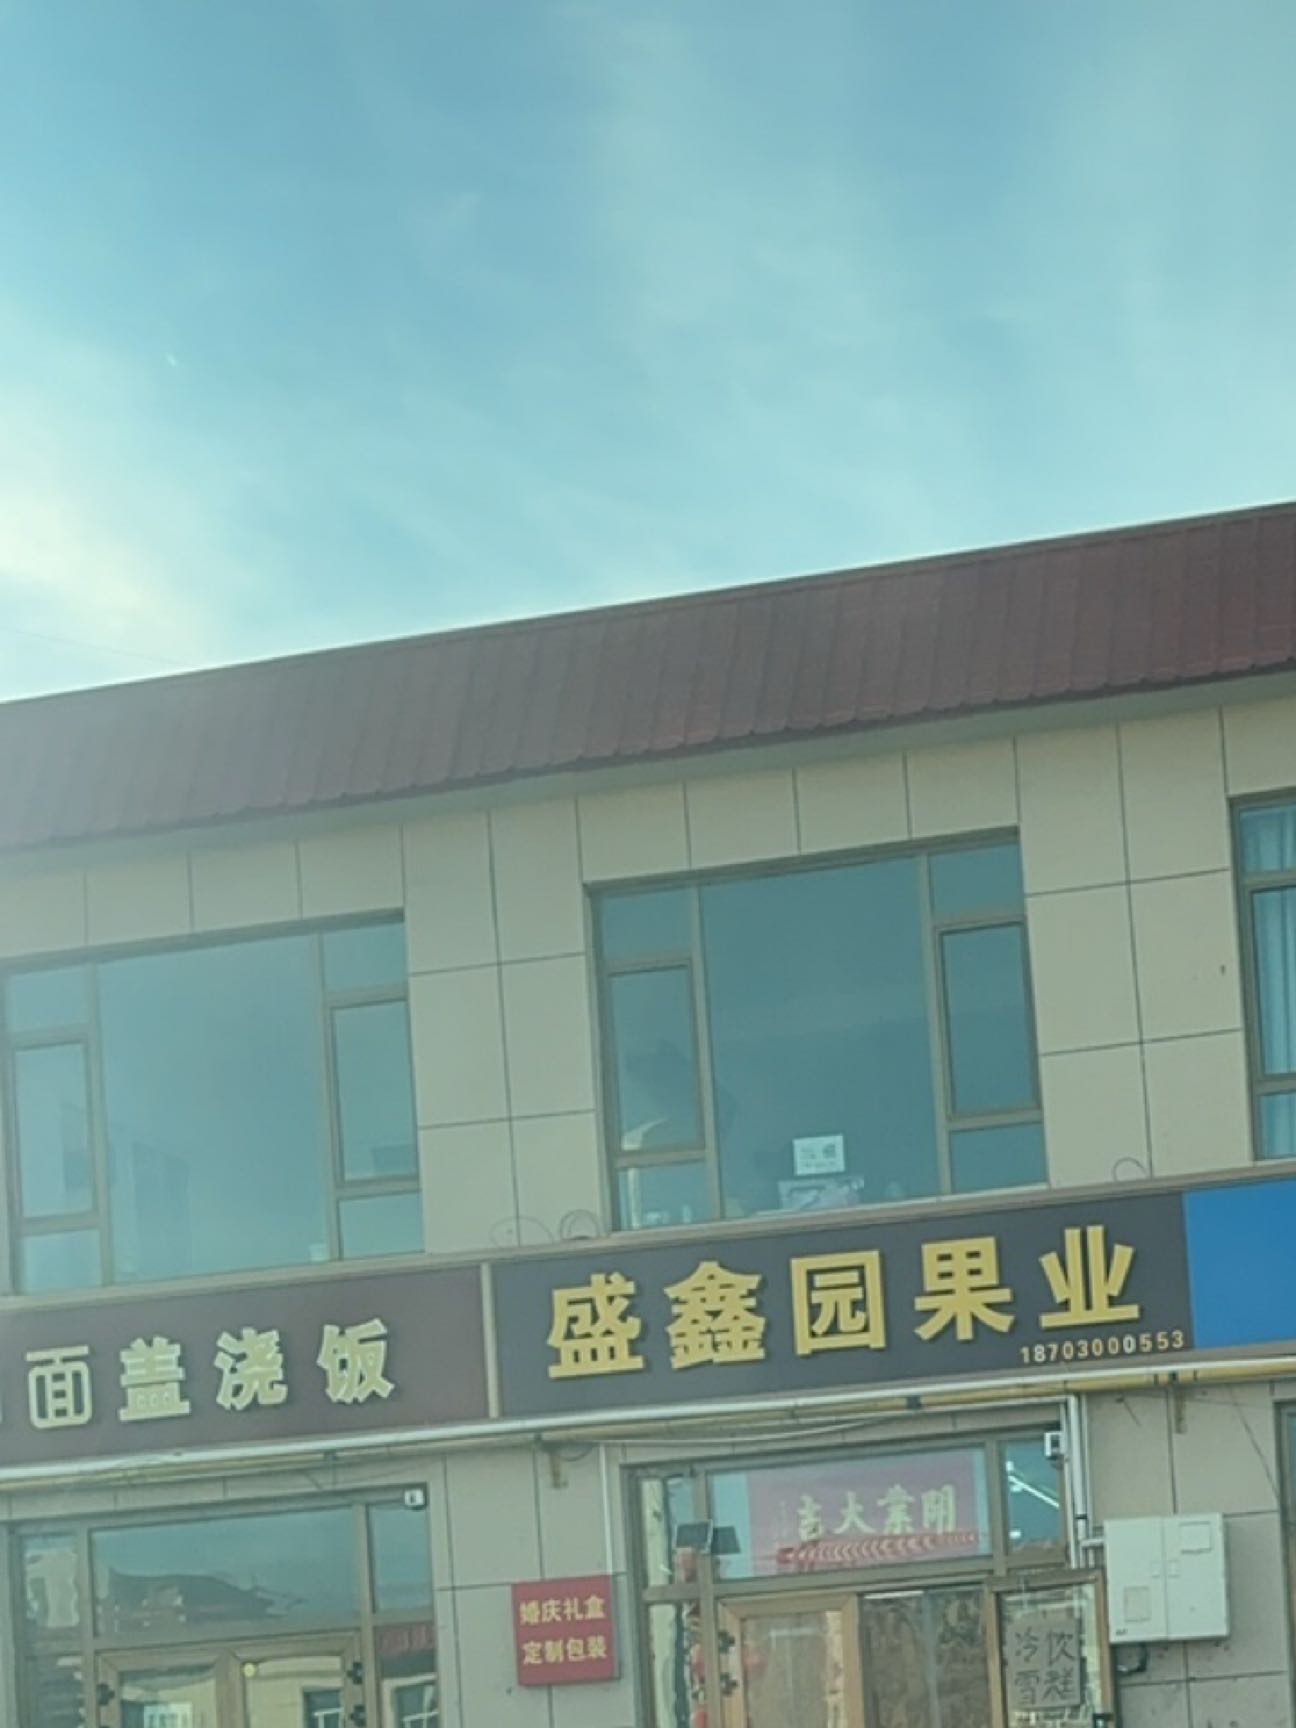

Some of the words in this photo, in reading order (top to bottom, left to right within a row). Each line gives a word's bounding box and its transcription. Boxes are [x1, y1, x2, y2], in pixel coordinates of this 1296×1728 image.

[546, 1223, 1141, 1380] 盛鑫园果业
[24, 1317, 396, 1430] 面盖浇饭
[1020, 1329, 1185, 1364] 18703000553
[523, 1635, 607, 1664] 定制包装
